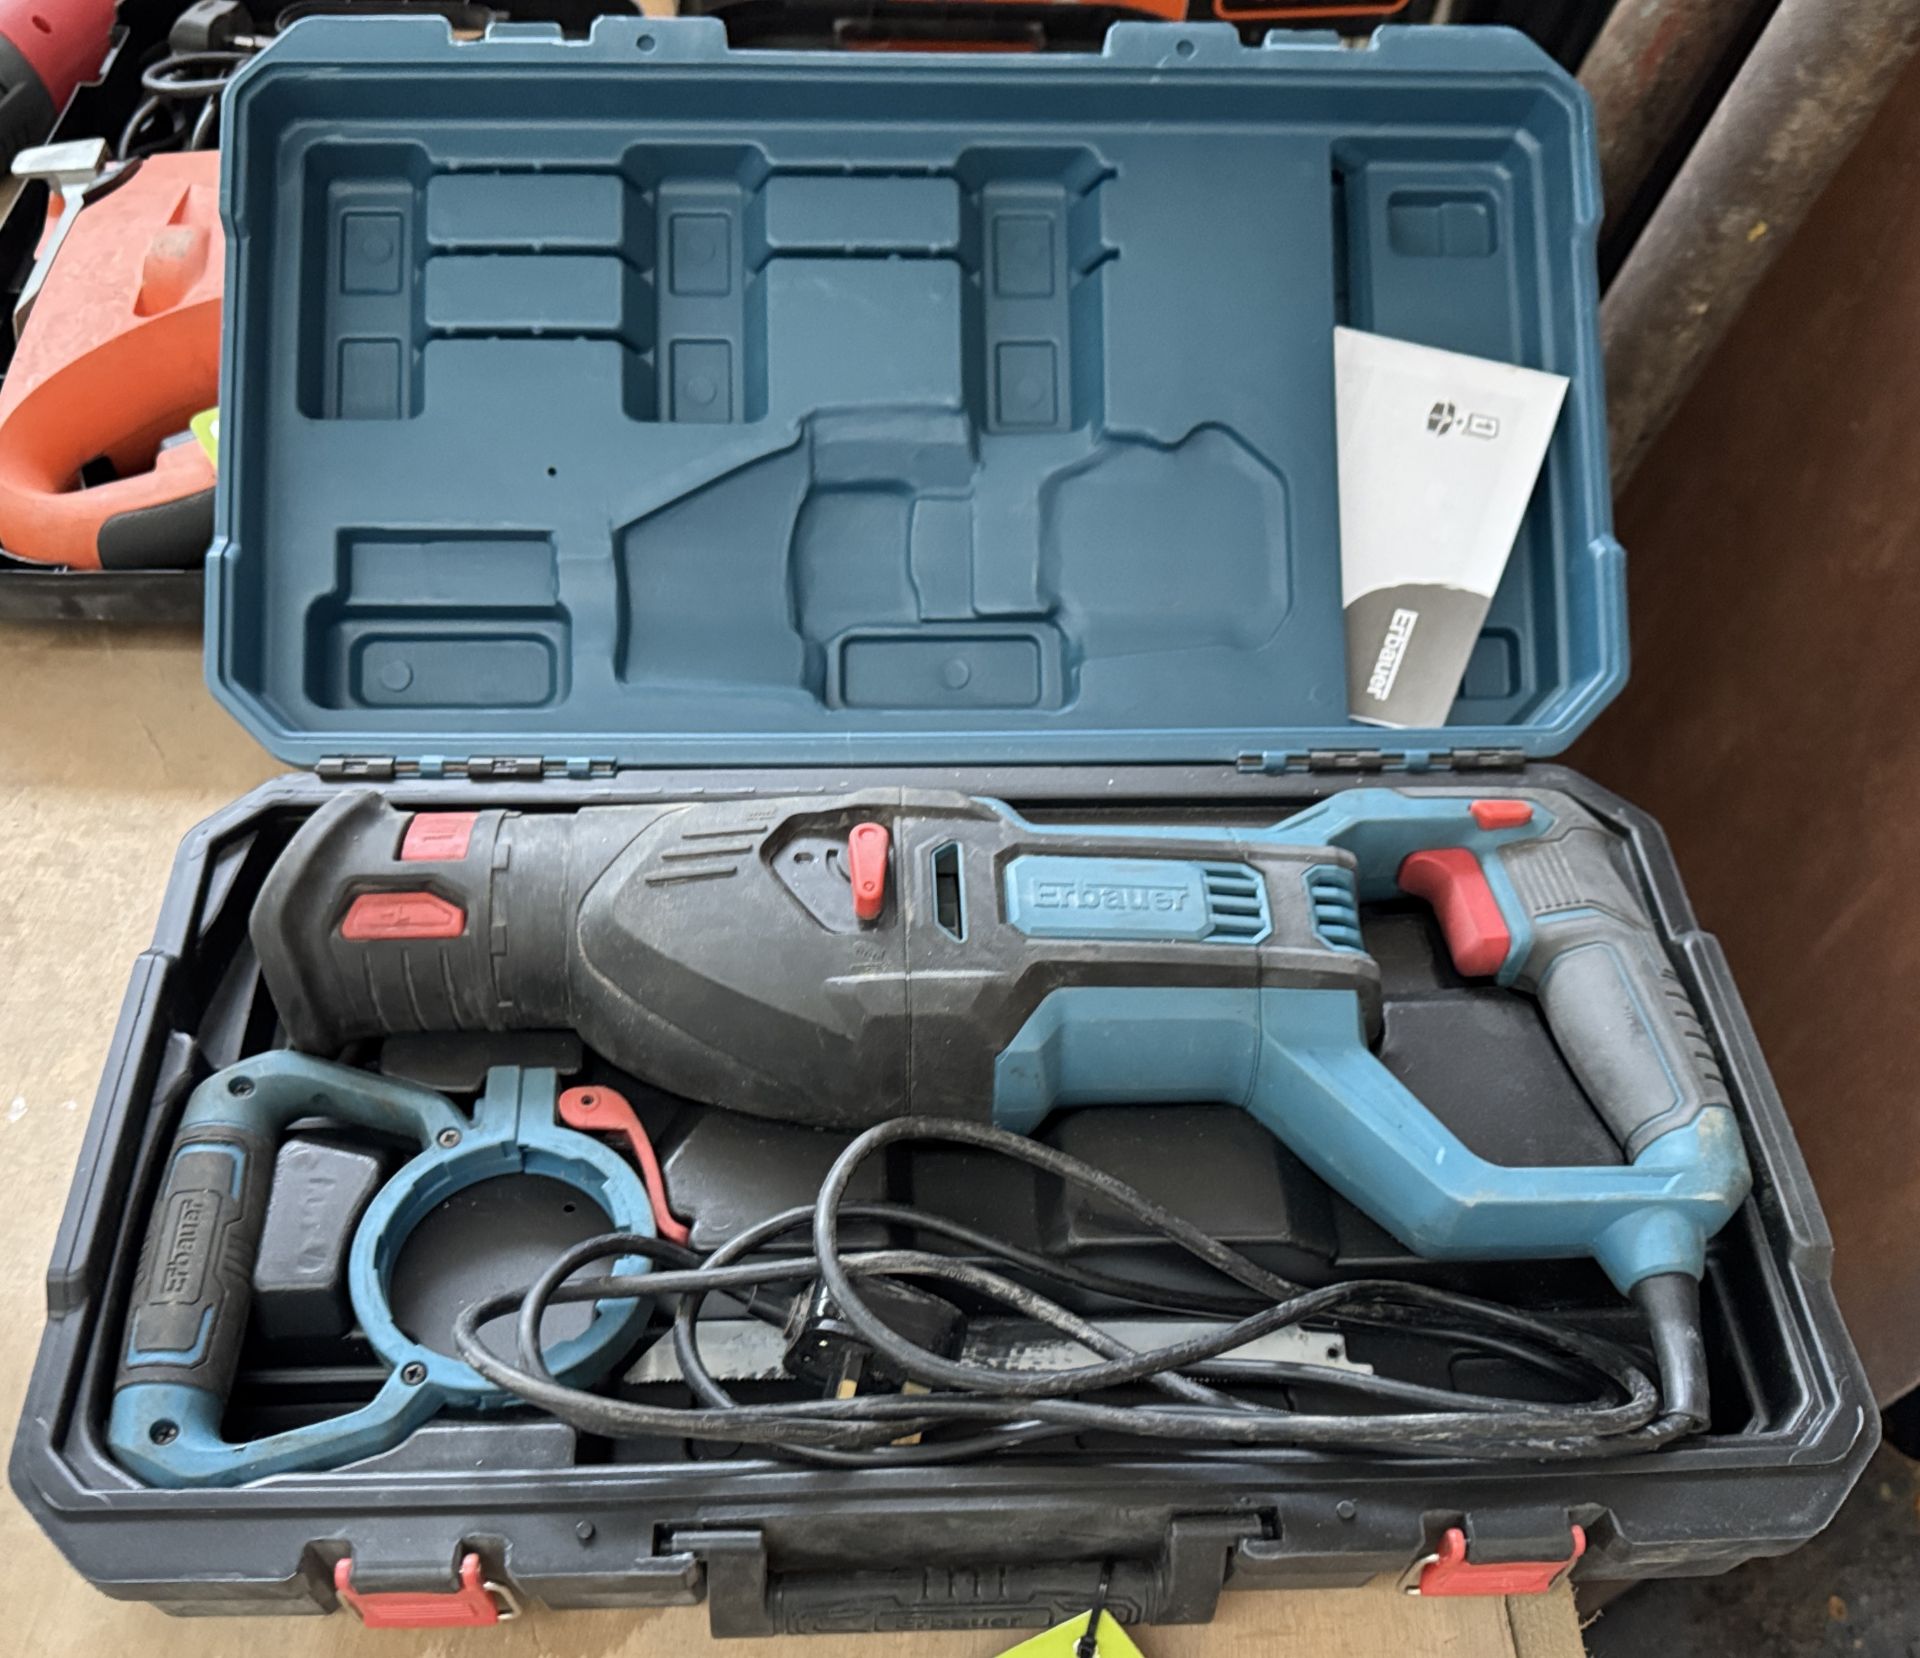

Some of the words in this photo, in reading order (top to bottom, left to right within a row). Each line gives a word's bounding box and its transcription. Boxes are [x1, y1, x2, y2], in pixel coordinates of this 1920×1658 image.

[1366, 608, 1419, 701] Erbauer
[1032, 881, 1190, 912] Erbauer
[160, 1198, 204, 1294] Erbauer
